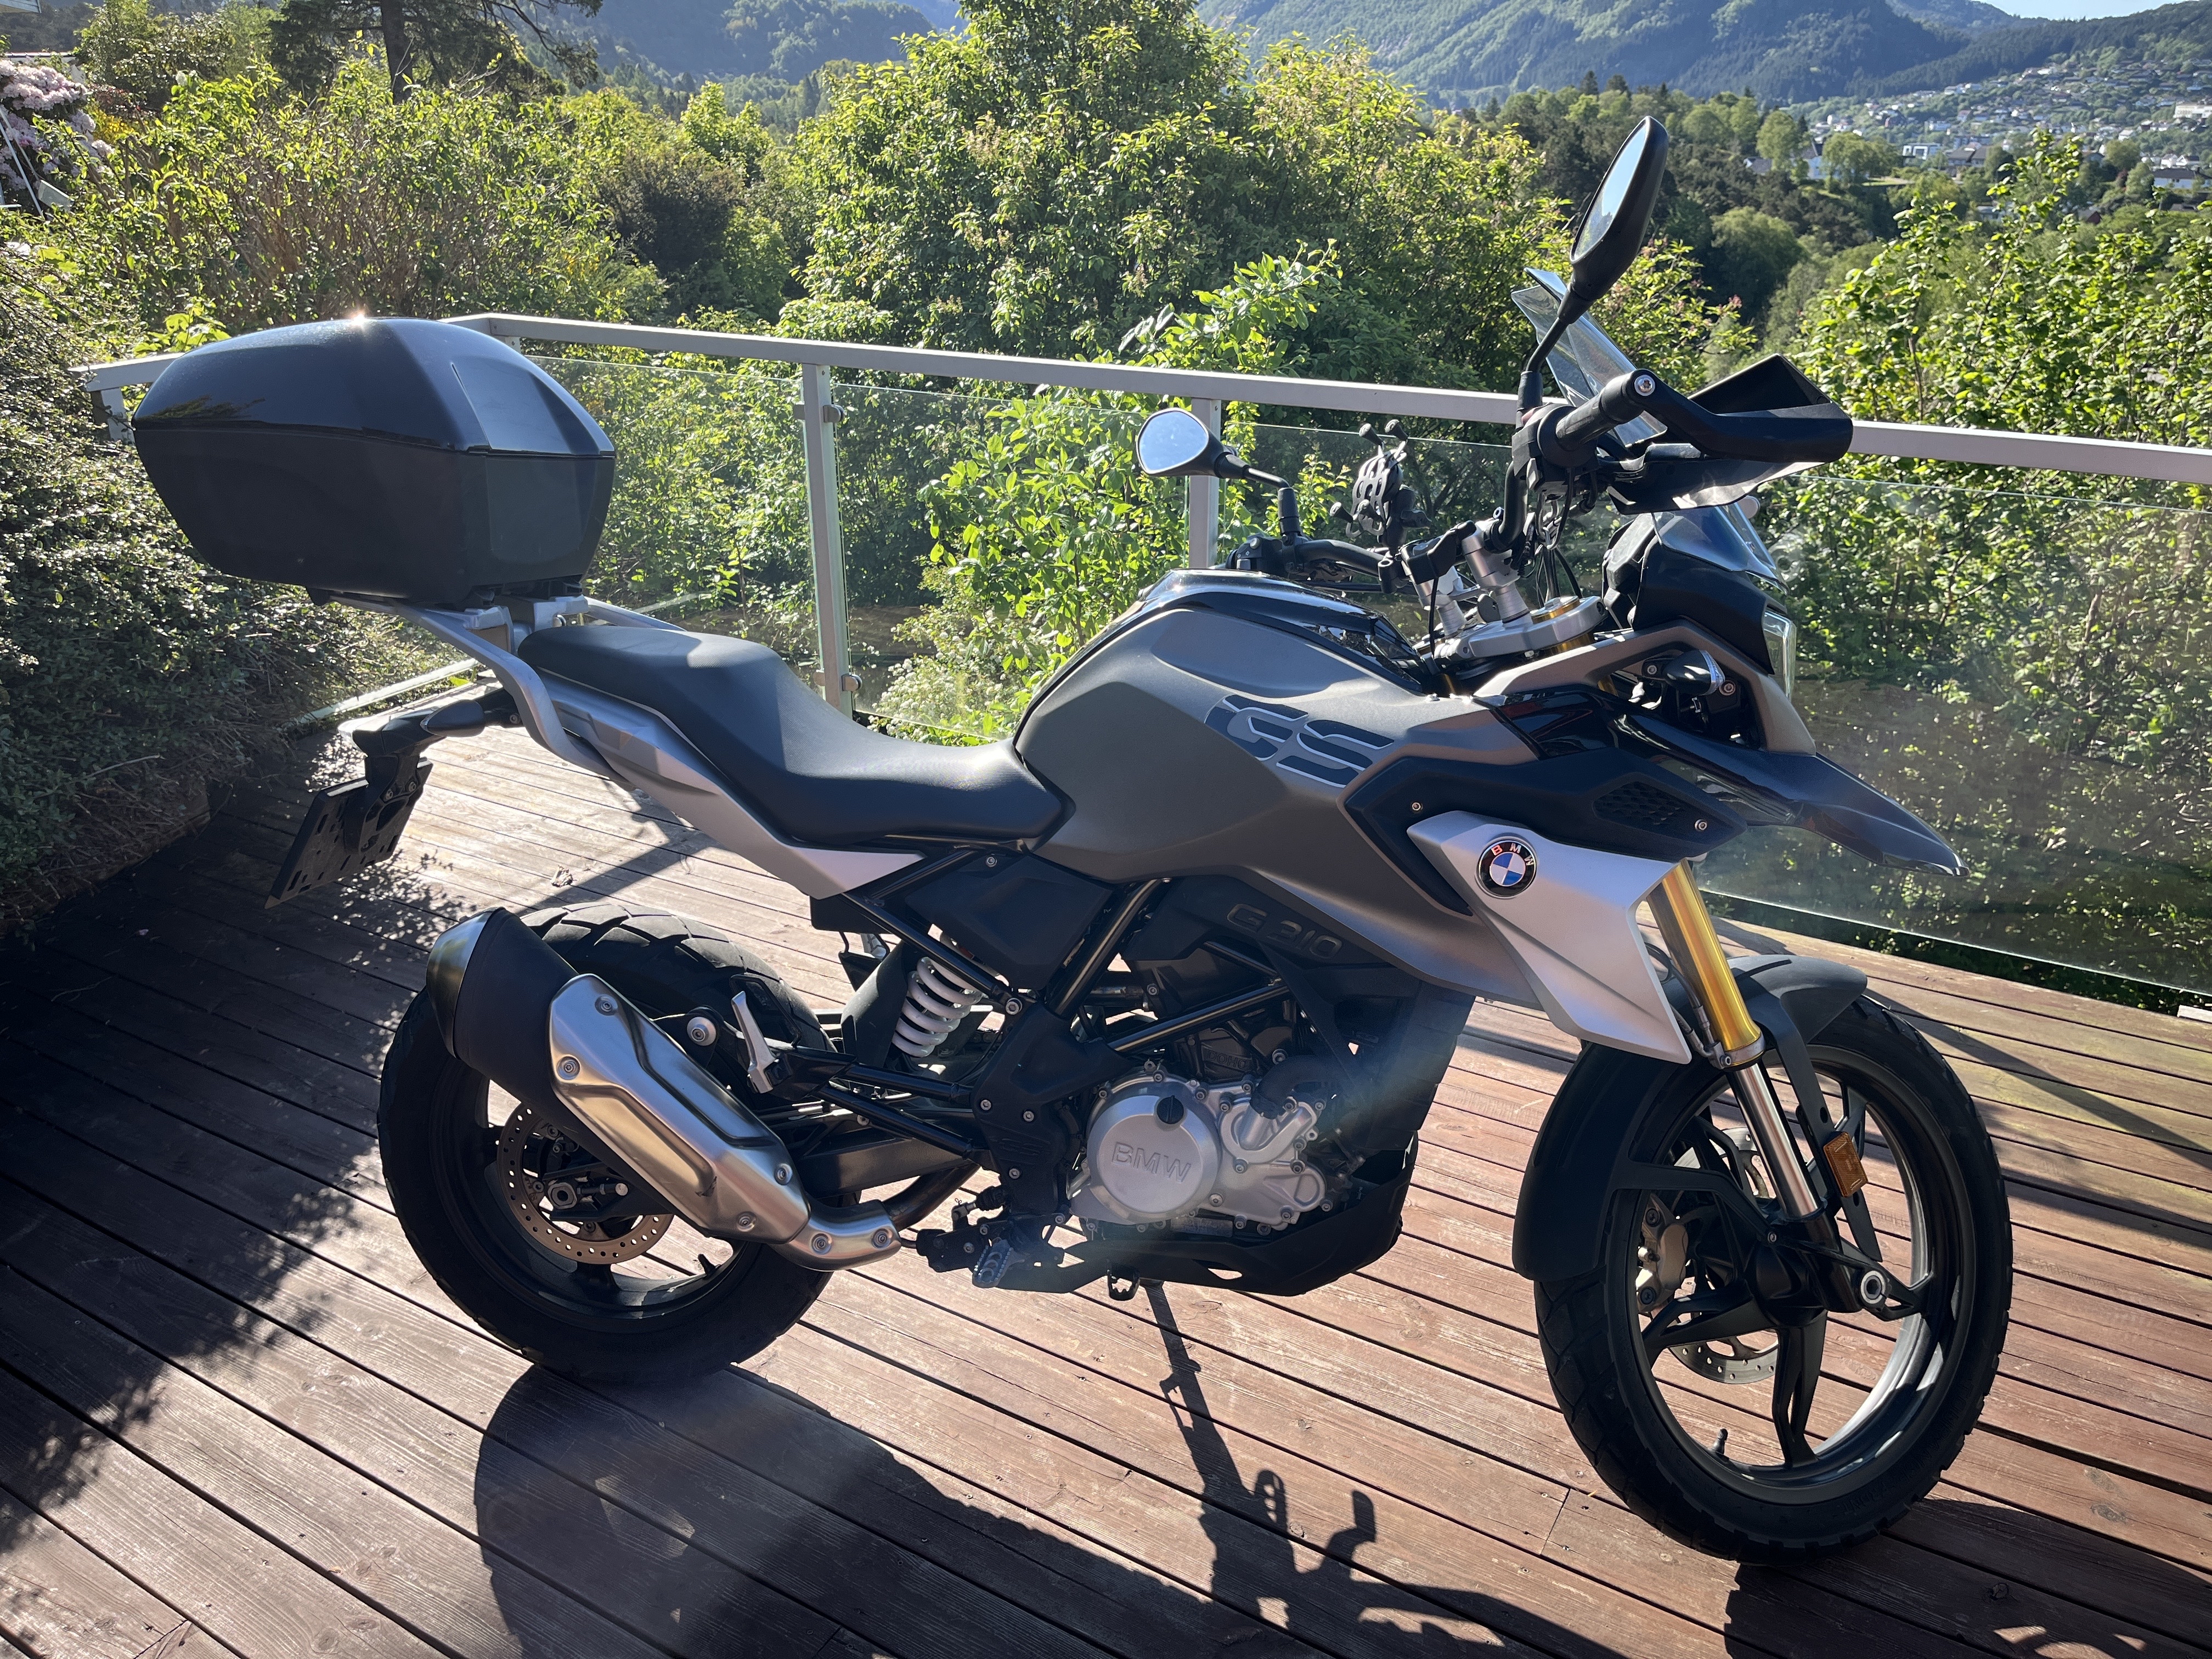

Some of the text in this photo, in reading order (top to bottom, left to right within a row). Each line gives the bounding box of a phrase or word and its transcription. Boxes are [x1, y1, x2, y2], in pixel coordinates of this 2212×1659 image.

[1204, 694, 1395, 788] GS
[1491, 842, 1534, 866] BMW
[1226, 903, 1342, 959] G 310
[1206, 1049, 1248, 1070] DOHC
[1111, 1141, 1192, 1183] BMW
